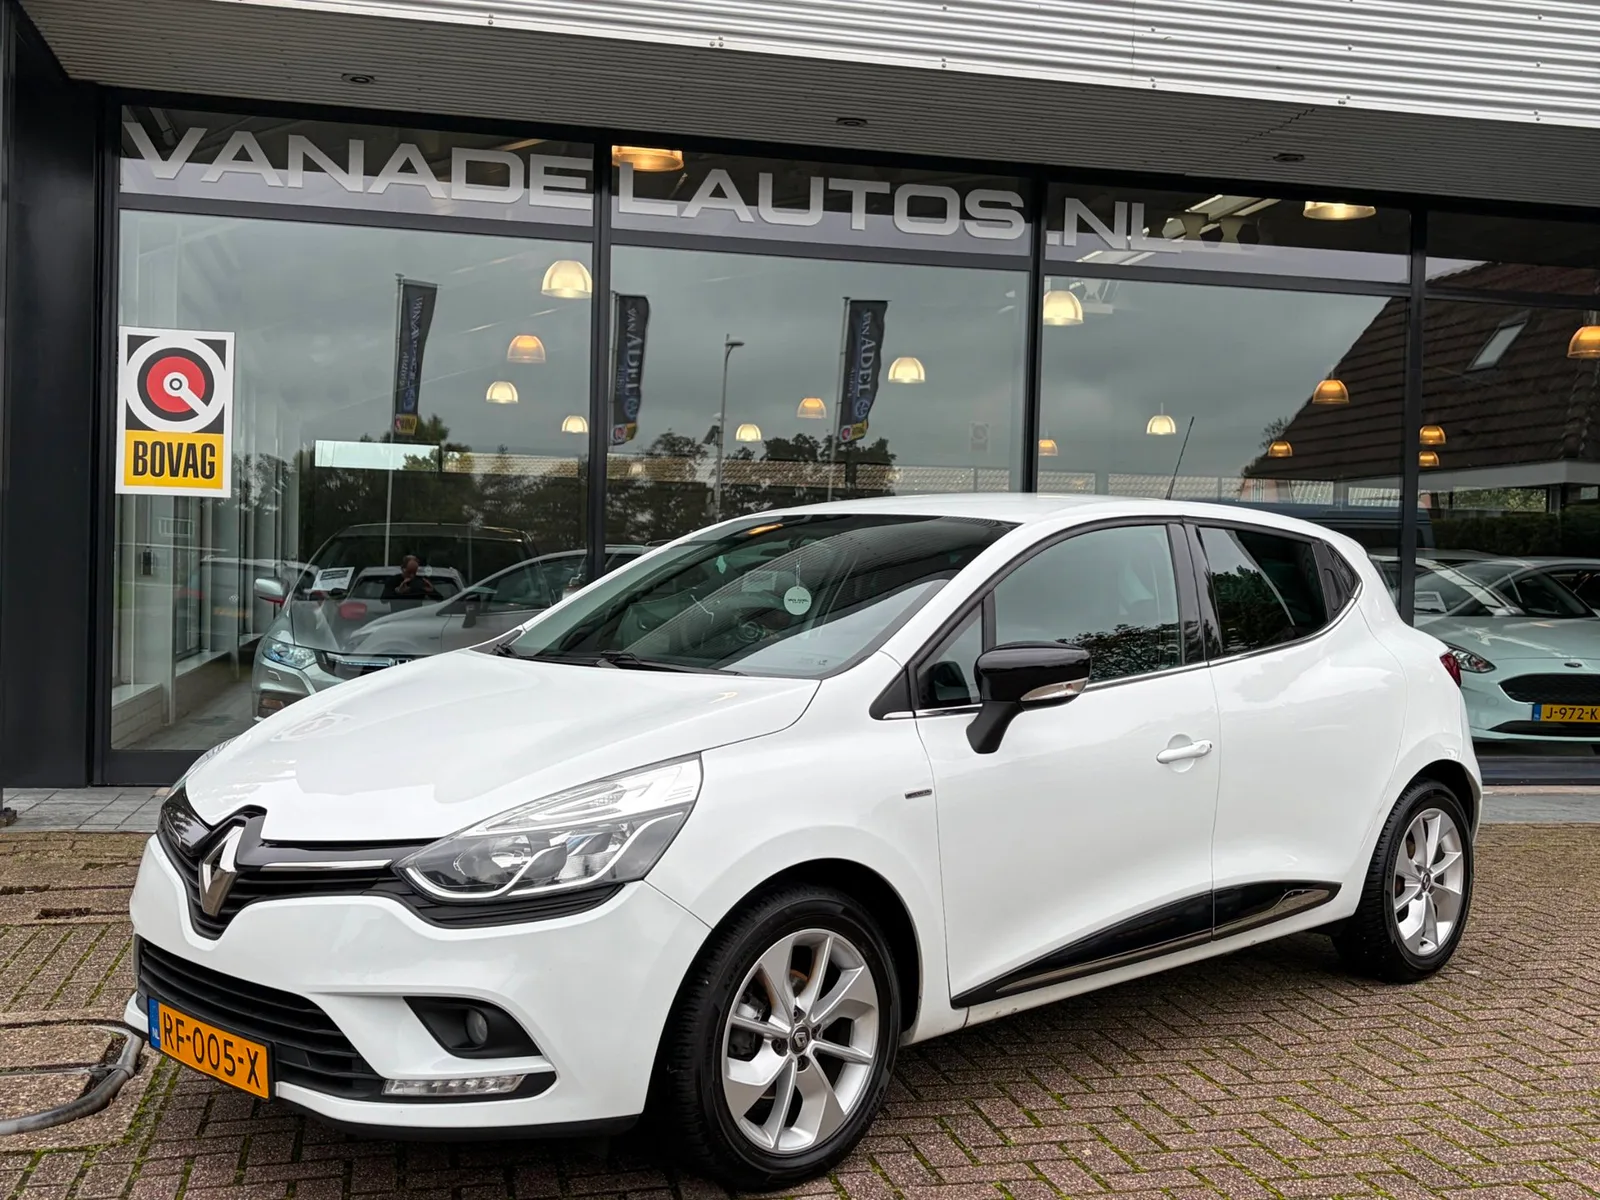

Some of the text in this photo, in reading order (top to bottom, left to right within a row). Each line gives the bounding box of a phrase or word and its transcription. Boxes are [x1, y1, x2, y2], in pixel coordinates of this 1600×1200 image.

[857, 336, 877, 397] ADEL
[132, 440, 216, 480] BOVAG
[1546, 707, 1598, 720] J-972-K
[163, 1011, 261, 1090] RF-005-X
